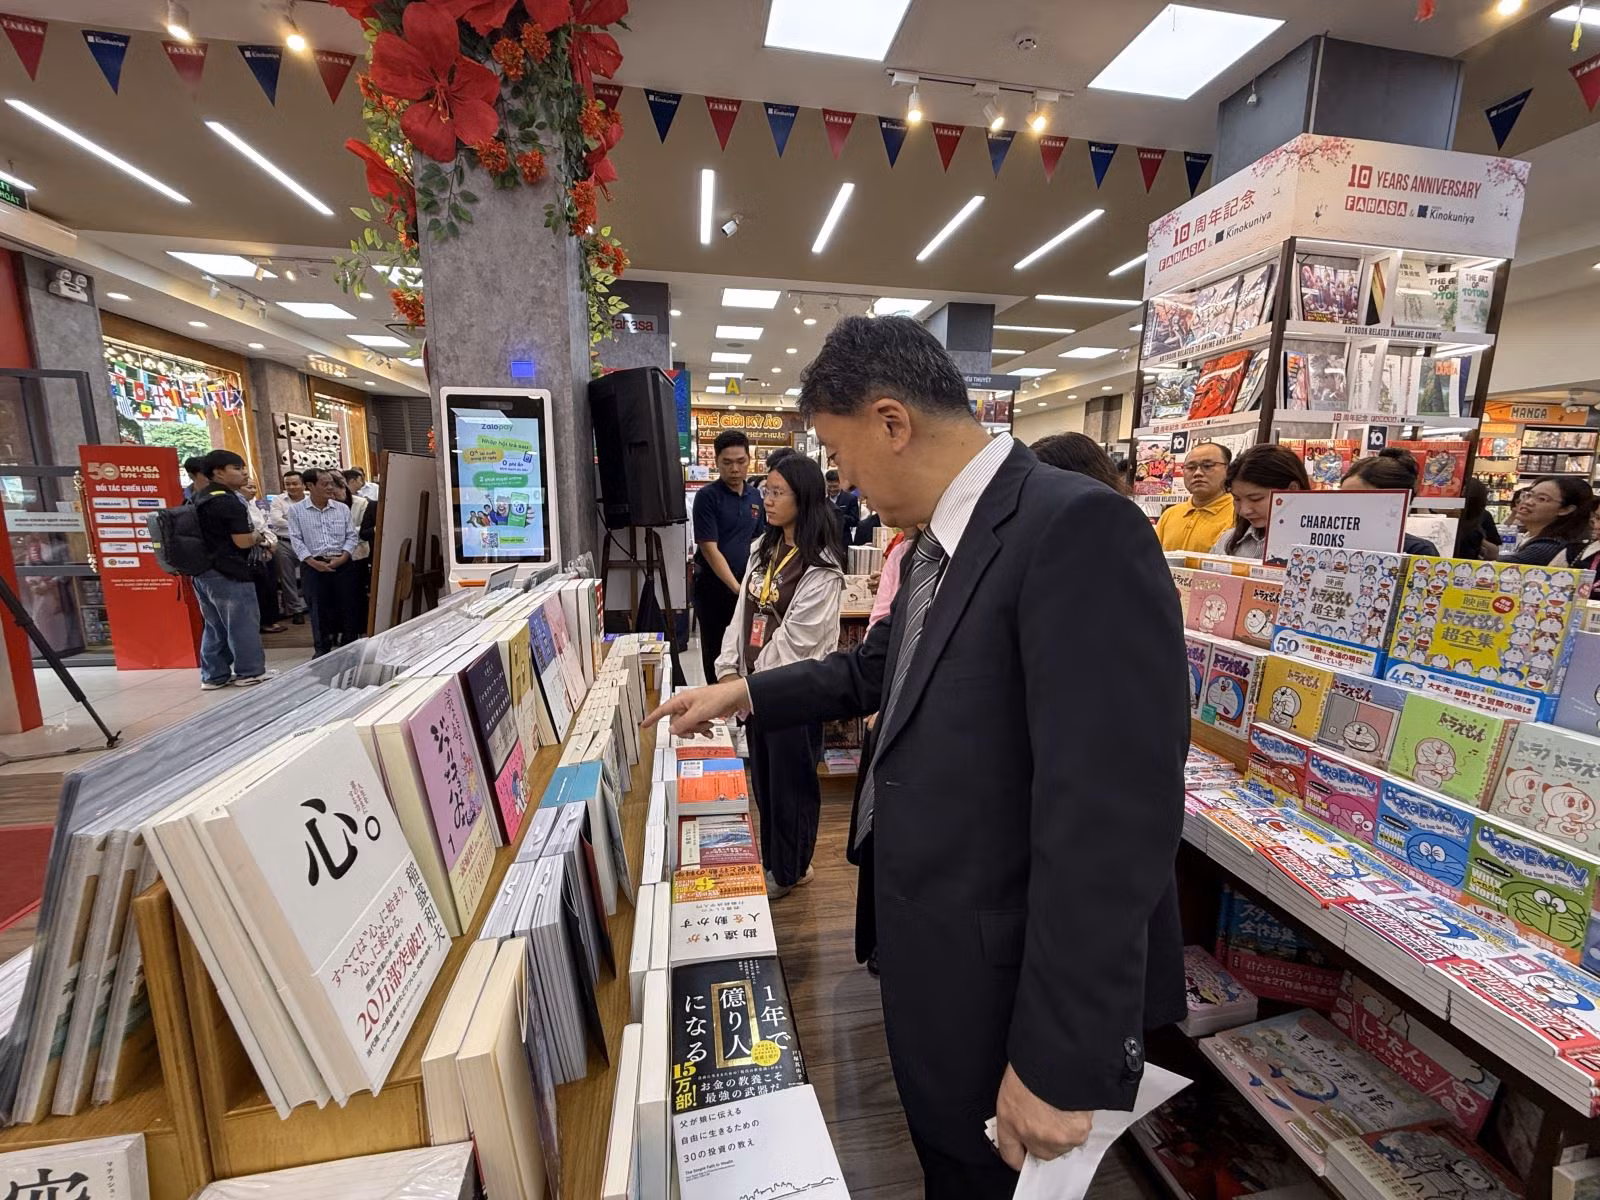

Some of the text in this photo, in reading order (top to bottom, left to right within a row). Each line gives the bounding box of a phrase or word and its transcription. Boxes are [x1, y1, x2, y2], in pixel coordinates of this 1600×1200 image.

[1348, 164, 1482, 199] 10 YEARS ANNIVERSARY
[1173, 189, 1257, 247] 10 周年記念
[1345, 195, 1408, 217] FAHASA
[1430, 209, 1475, 224] Kinokuniya
[1159, 238, 1206, 272] FAHASA
[1226, 211, 1272, 240] Kinokuniya
[1465, 274, 1477, 282] THE
[726, 377, 740, 395] A
[697, 411, 783, 429] THẾ GIỚI KỲ ẢO
[1511, 407, 1547, 419] MANGA
[481, 423, 513, 431] Zalopay
[88, 462, 120, 480] 50
[1300, 514, 1360, 531] CHARACTER
[1310, 532, 1345, 547] BOOKS
[1311, 602, 1346, 620] 超全集
[1276, 637, 1299, 652] 50
[1442, 627, 1495, 649] 超全集
[301, 798, 381, 886] 心。
[1378, 824, 1406, 842] Comic
[405, 860, 446, 950] 稲盛和夫
[680, 912, 760, 929] 人を動かす
[685, 927, 757, 946] 勘違いが
[357, 924, 428, 1041] 20万部突破!!
[720, 987, 751, 1059] 億り人
[761, 985, 792, 1050] 1年で
[685, 995, 707, 1063] になる
[701, 1071, 783, 1092] お金の教養こそ
[679, 1106, 742, 1129] 父が娘に伝える
[681, 1119, 760, 1146] 自由に生きるための
[683, 1138, 756, 1164] 30の投資の教え
